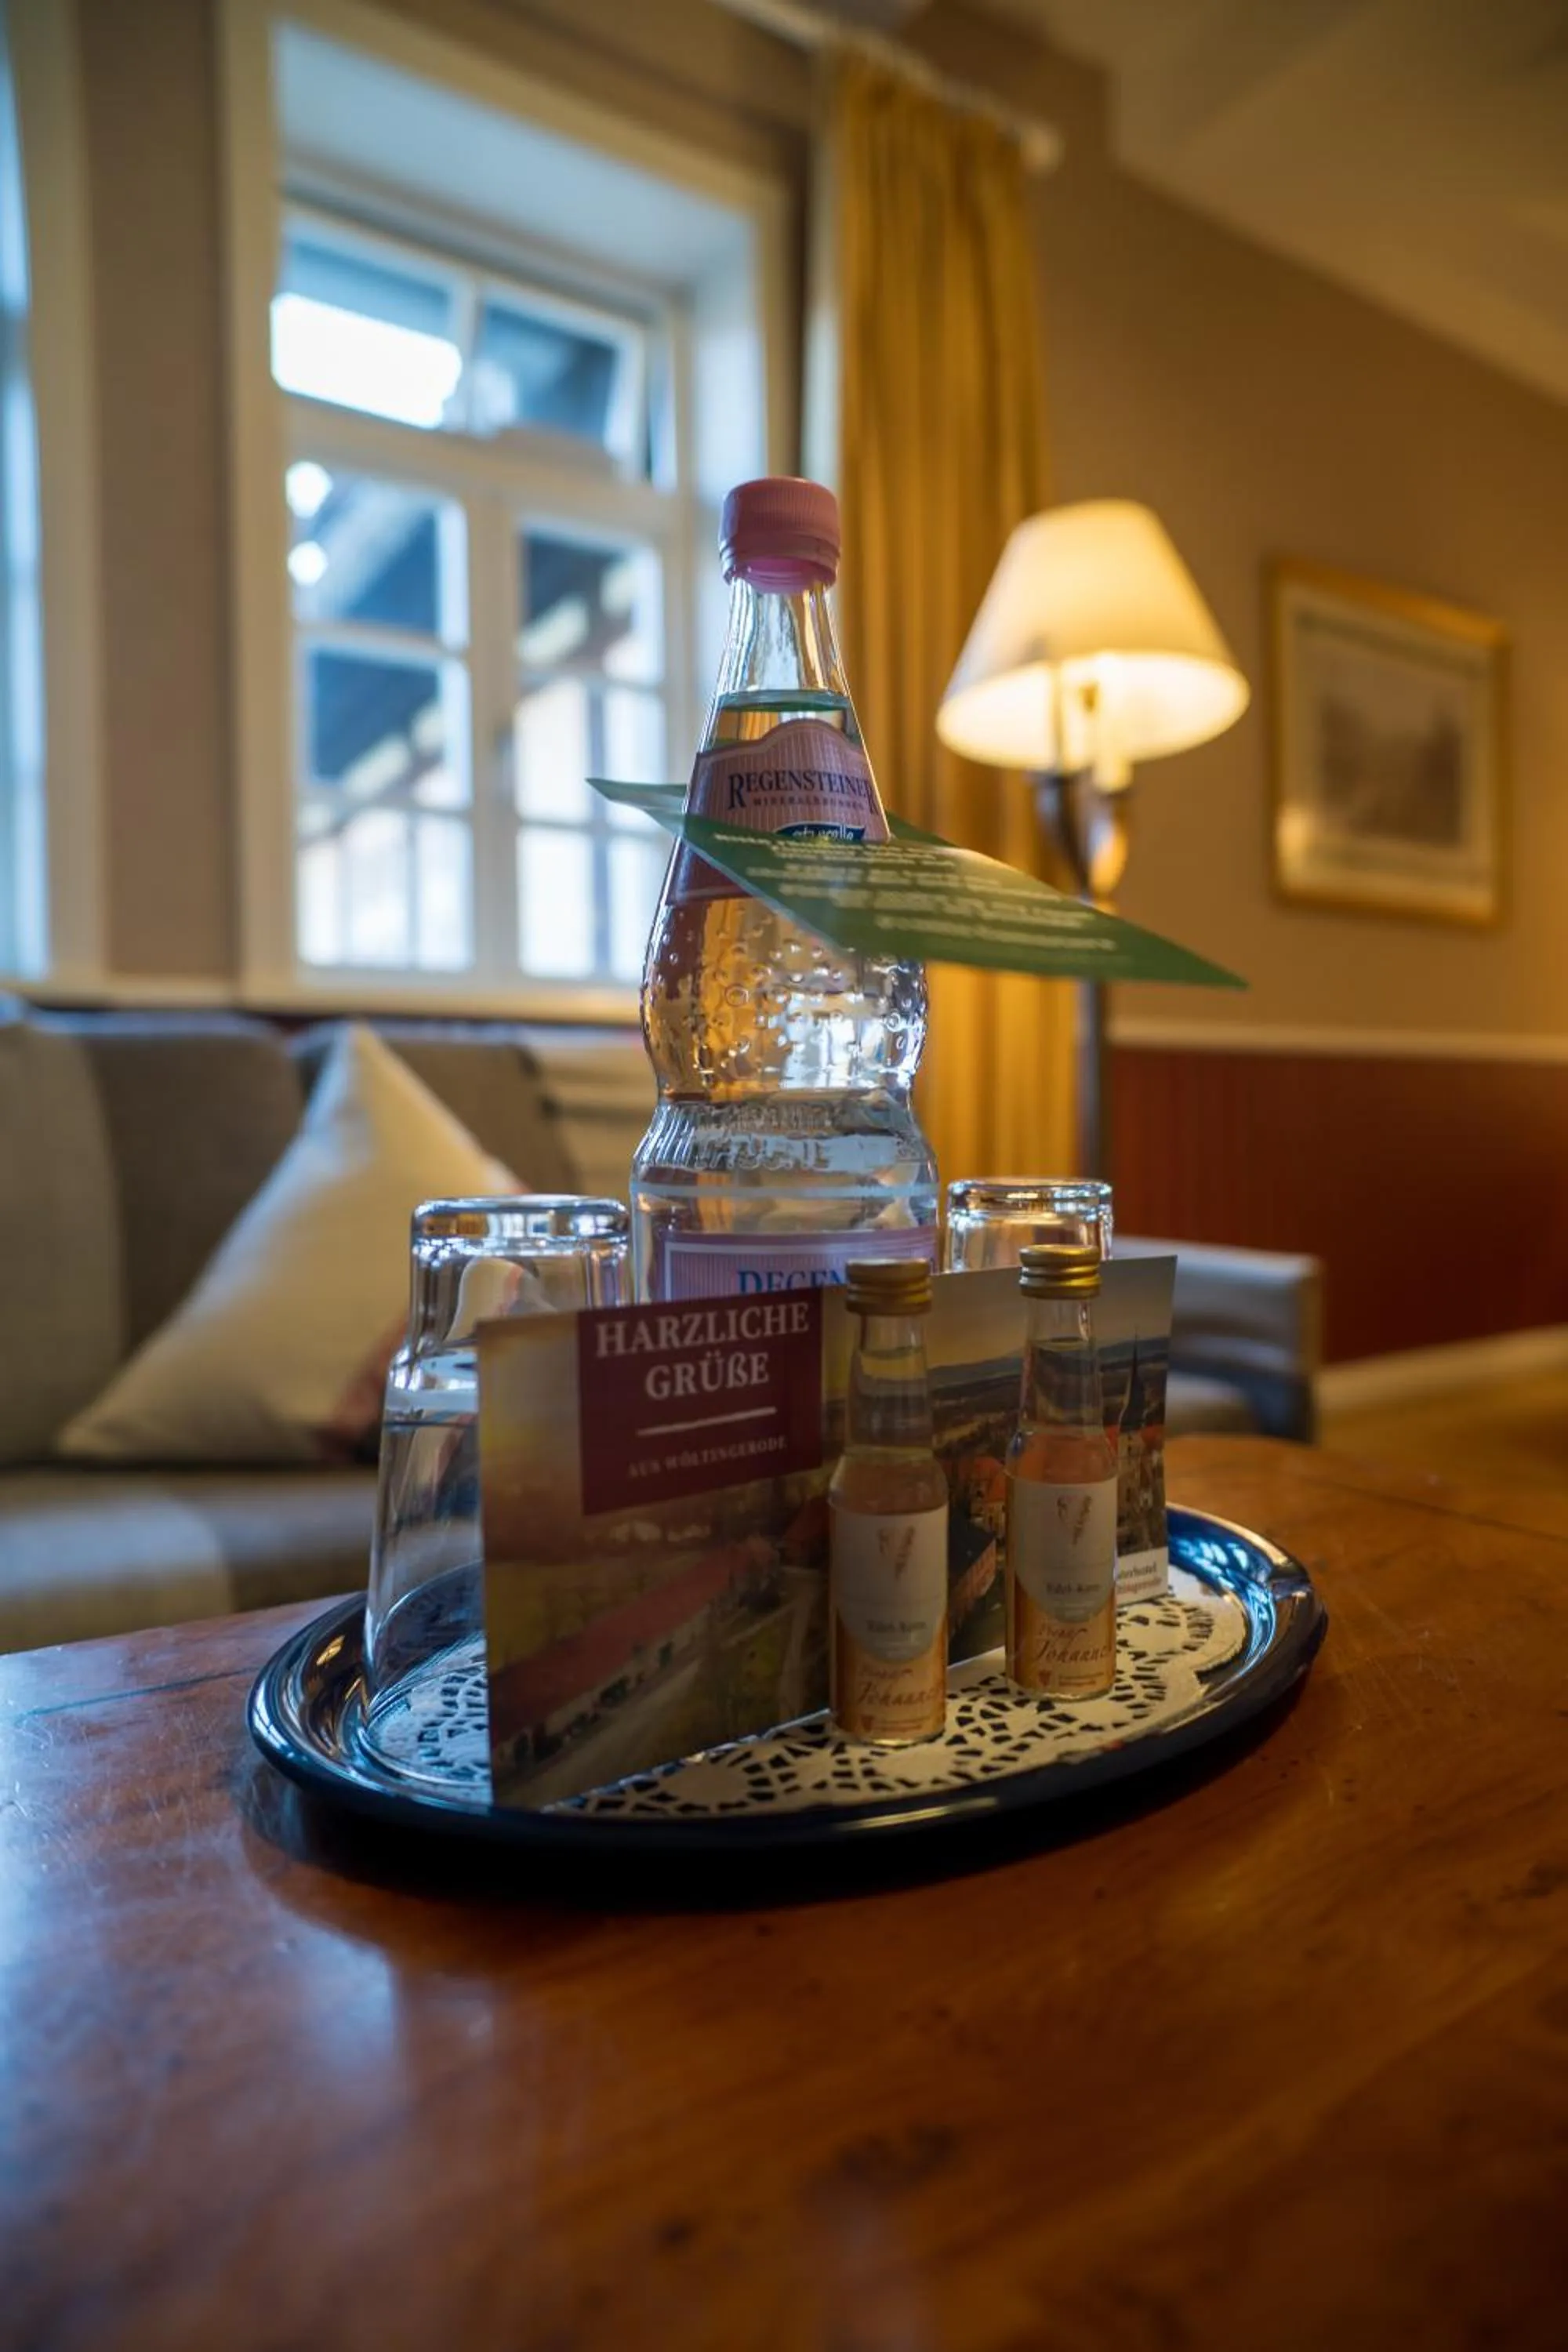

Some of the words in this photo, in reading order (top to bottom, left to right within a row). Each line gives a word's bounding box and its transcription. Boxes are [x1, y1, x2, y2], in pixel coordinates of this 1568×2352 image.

[728, 769, 879, 815] REGENSTEINER
[596, 1301, 810, 1358] HARZLICHE
[644, 1349, 769, 1400] GRÜßE
